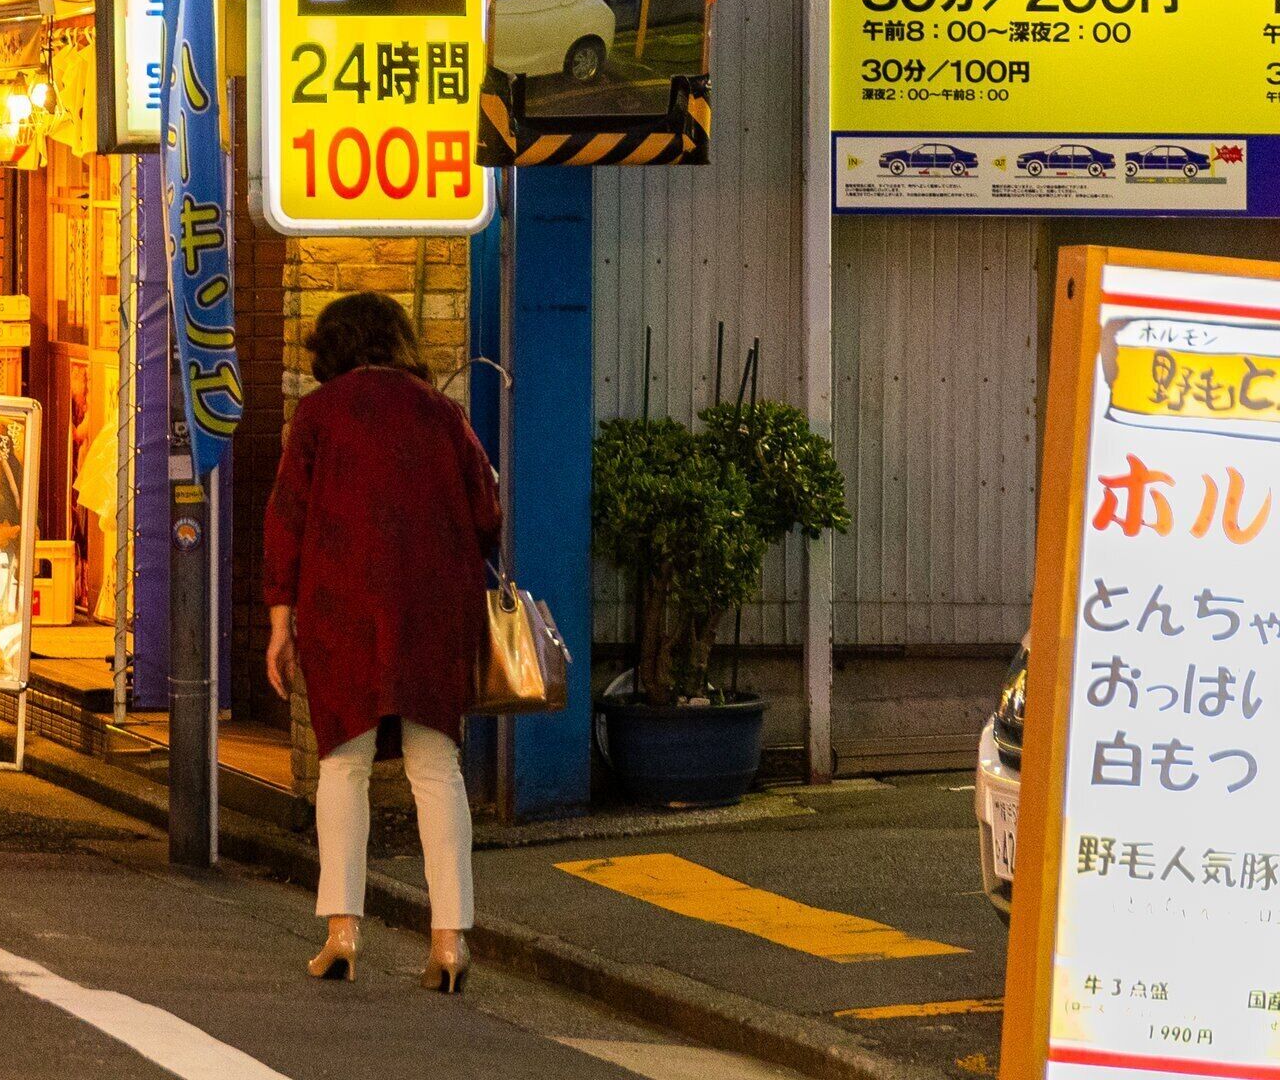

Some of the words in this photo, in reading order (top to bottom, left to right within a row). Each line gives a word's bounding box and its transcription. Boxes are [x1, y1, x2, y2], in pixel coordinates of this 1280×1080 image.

[291, 40, 470, 105] 24時間
[861, 58, 1031, 84] 30分／100円
[292, 127, 471, 200] 100円
[848, 158, 858, 166] IN
[1139, 323, 1218, 347] ホルモン
[1148, 350, 1280, 411] 野毛と
[1090, 730, 1259, 794] 白もつ
[1077, 834, 1280, 892] 野毛人気豚
[1148, 1024, 1214, 1046] 1990円
